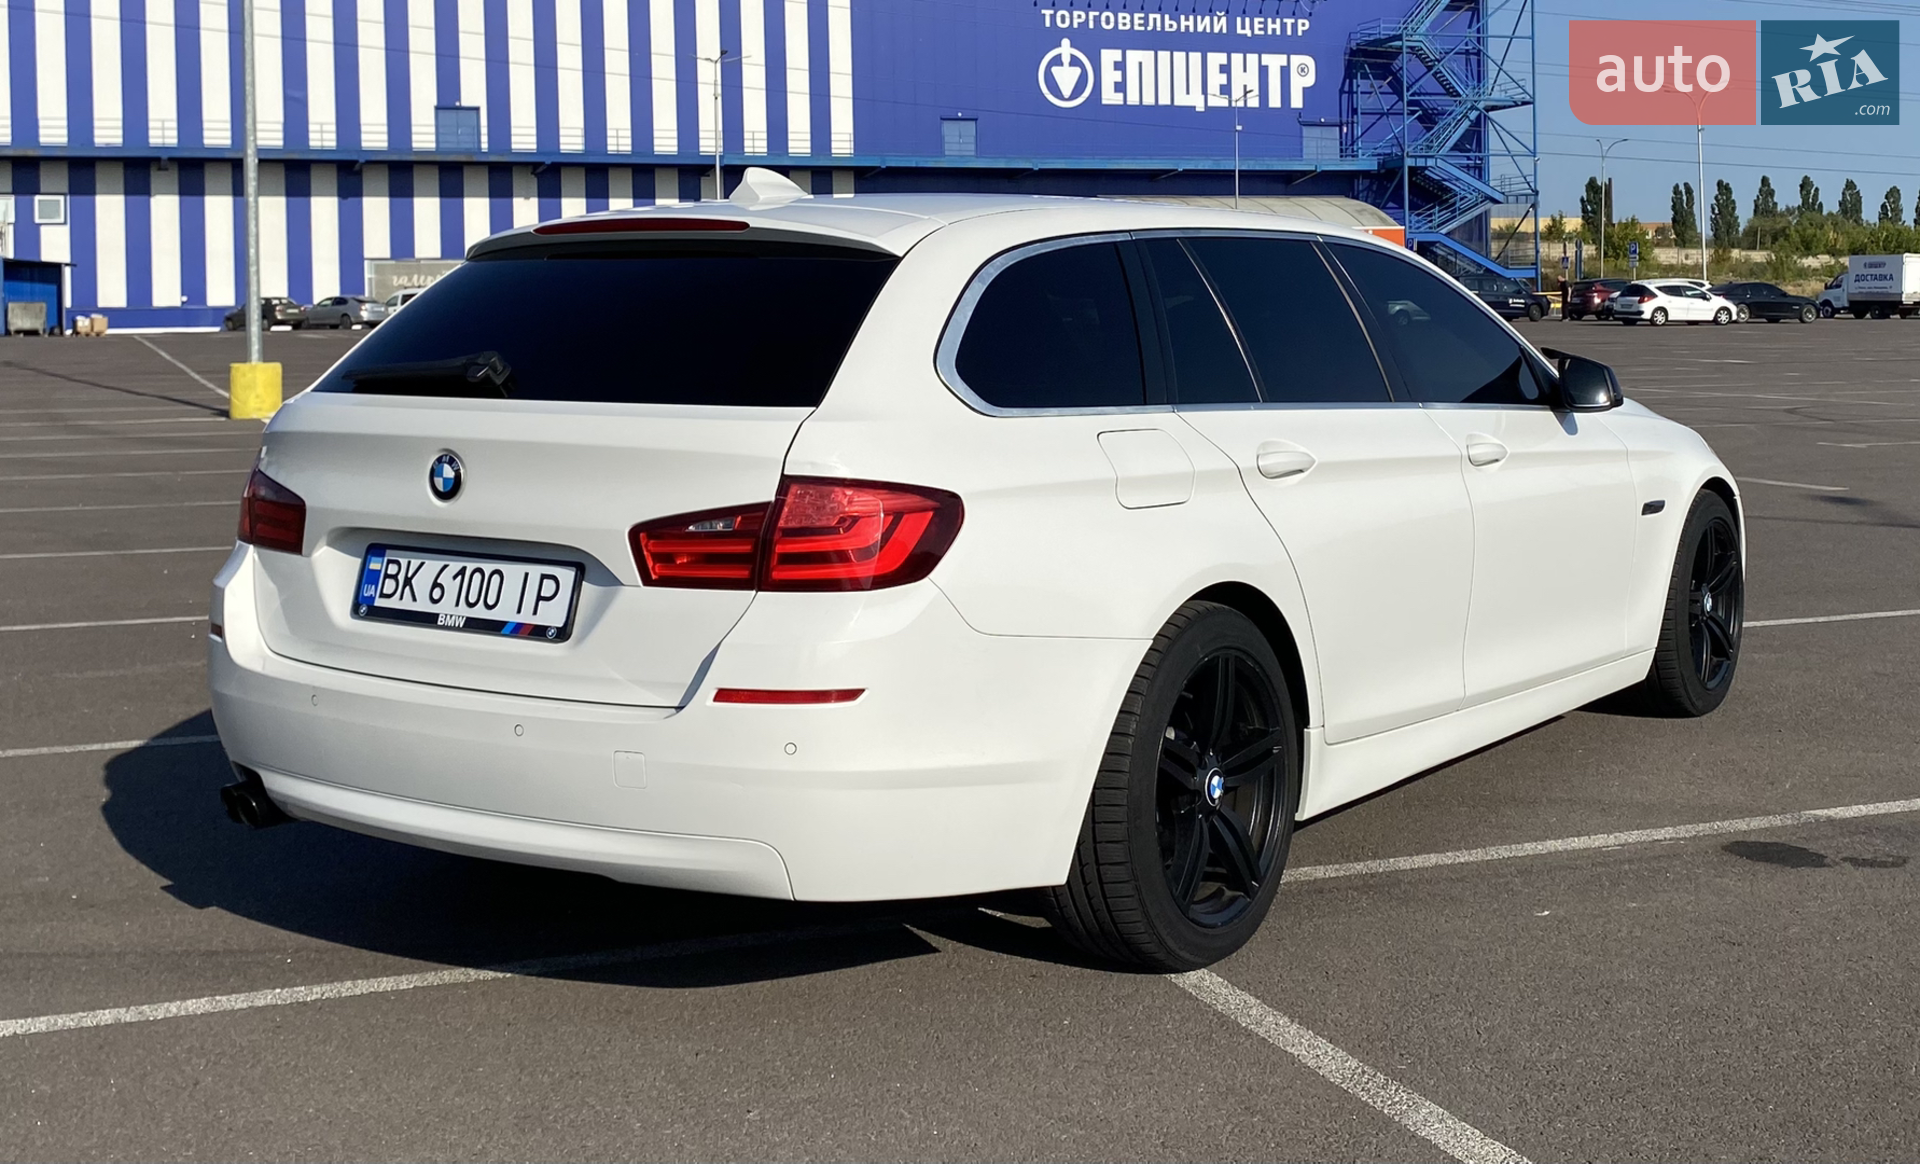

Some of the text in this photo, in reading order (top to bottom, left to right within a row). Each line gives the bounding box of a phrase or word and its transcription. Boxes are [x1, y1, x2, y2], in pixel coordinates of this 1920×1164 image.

[1041, 9, 1310, 37] ТОРГОВЕЛЬНИЙ ЦЕНТР
[1100, 49, 1317, 111] ЕПІЦЕНТР
[1854, 273, 1894, 283] ДОСТАВКА
[363, 584, 376, 597] UA
[379, 558, 560, 616] BK 6100 IP
[437, 613, 467, 628] BMW
